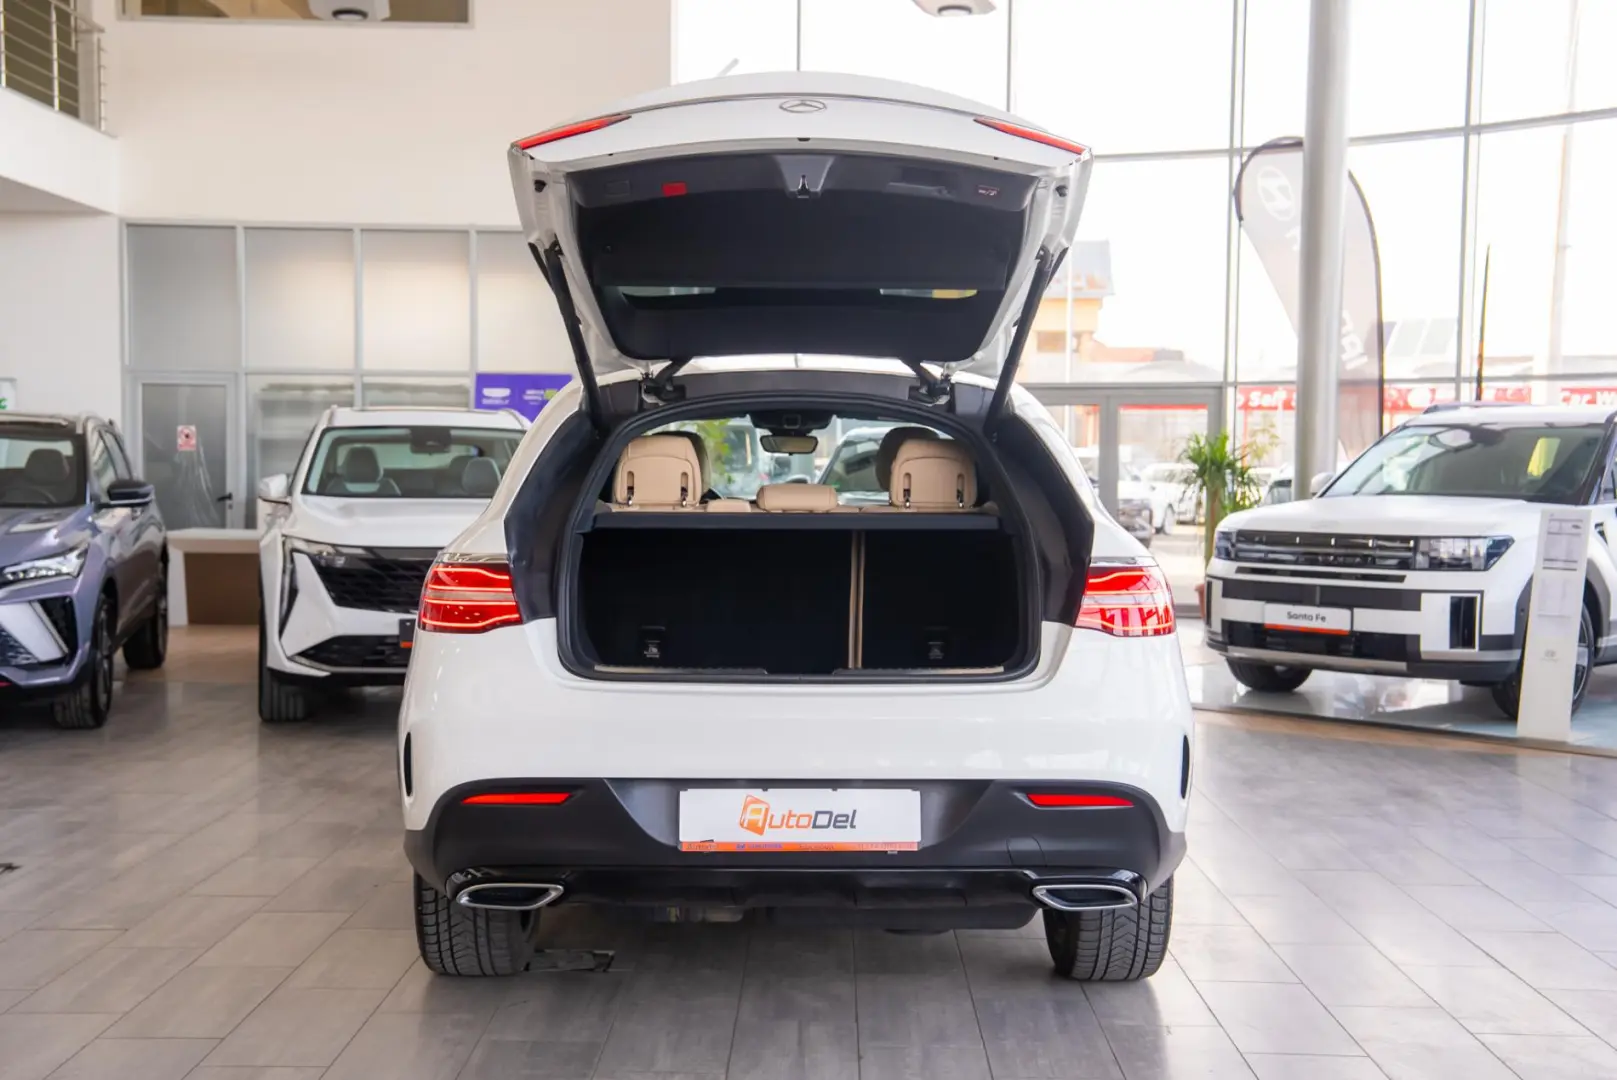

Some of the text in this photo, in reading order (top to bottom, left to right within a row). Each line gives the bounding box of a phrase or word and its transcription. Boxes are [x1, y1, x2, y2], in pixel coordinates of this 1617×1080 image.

[1286, 611, 1327, 623] Santa Fe
[741, 803, 857, 829] AutoDel
